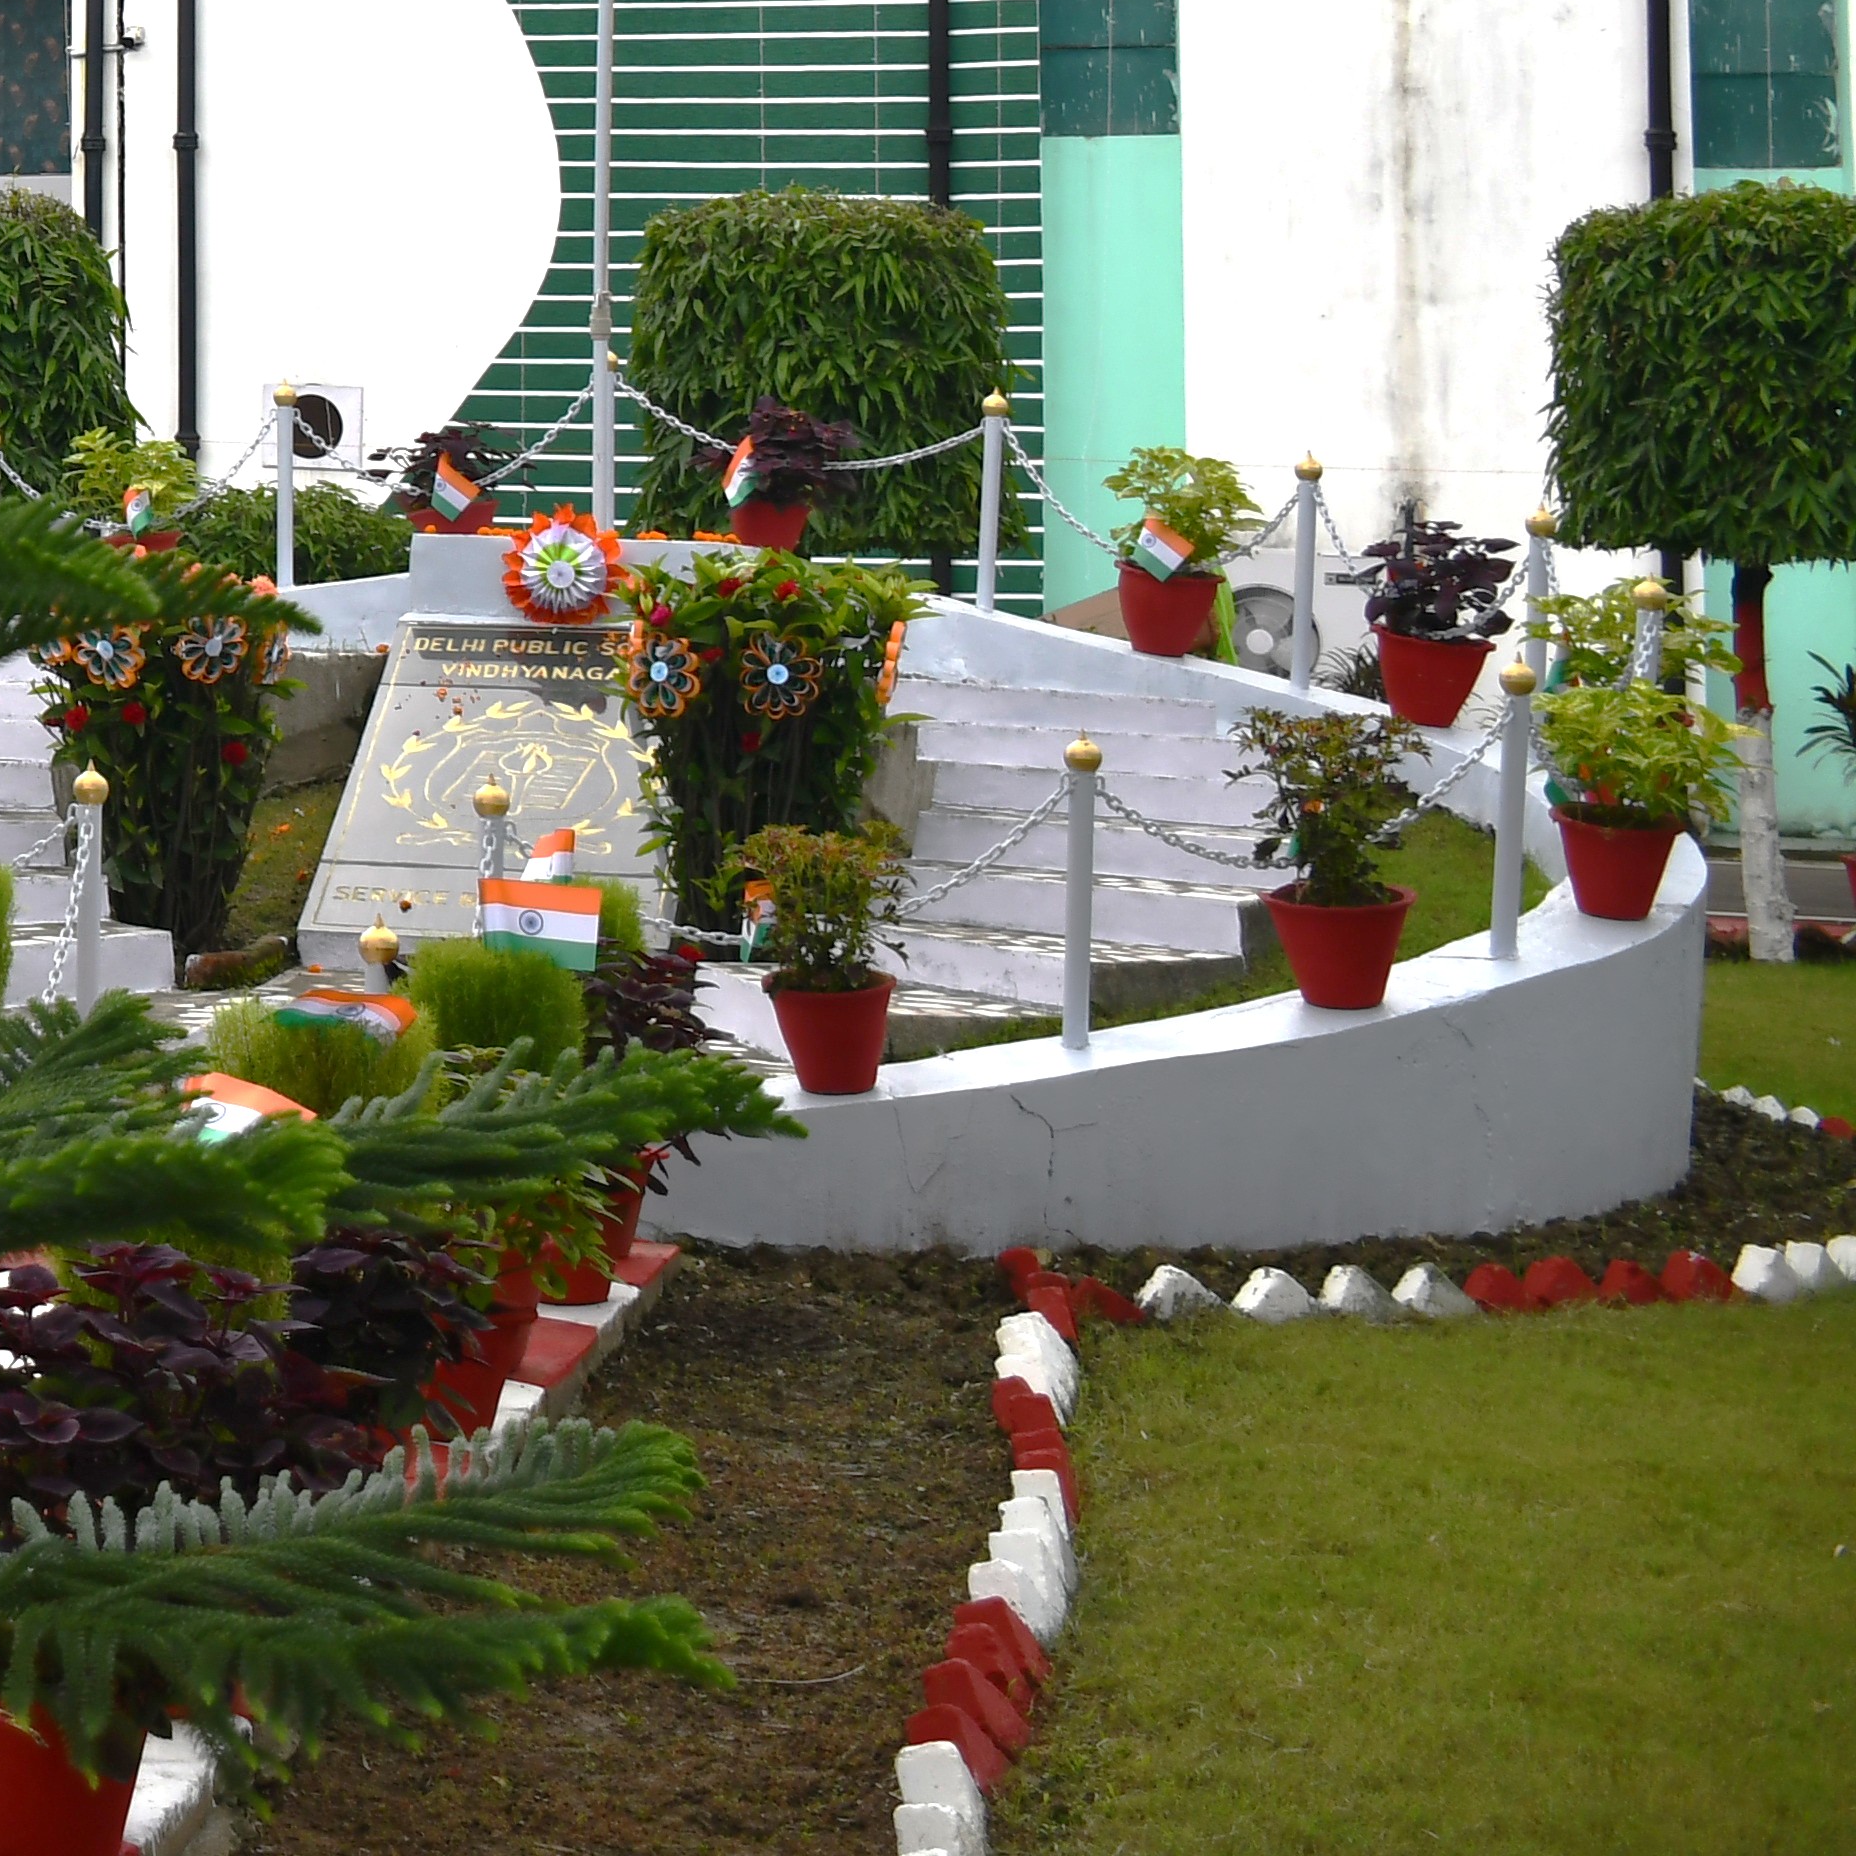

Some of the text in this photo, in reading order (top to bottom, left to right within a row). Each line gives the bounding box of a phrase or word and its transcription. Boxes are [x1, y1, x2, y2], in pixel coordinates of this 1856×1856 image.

[414, 637, 486, 653] DELHI
[492, 638, 589, 656] PUBLIC
[441, 662, 620, 681] VINDHYANAGA
